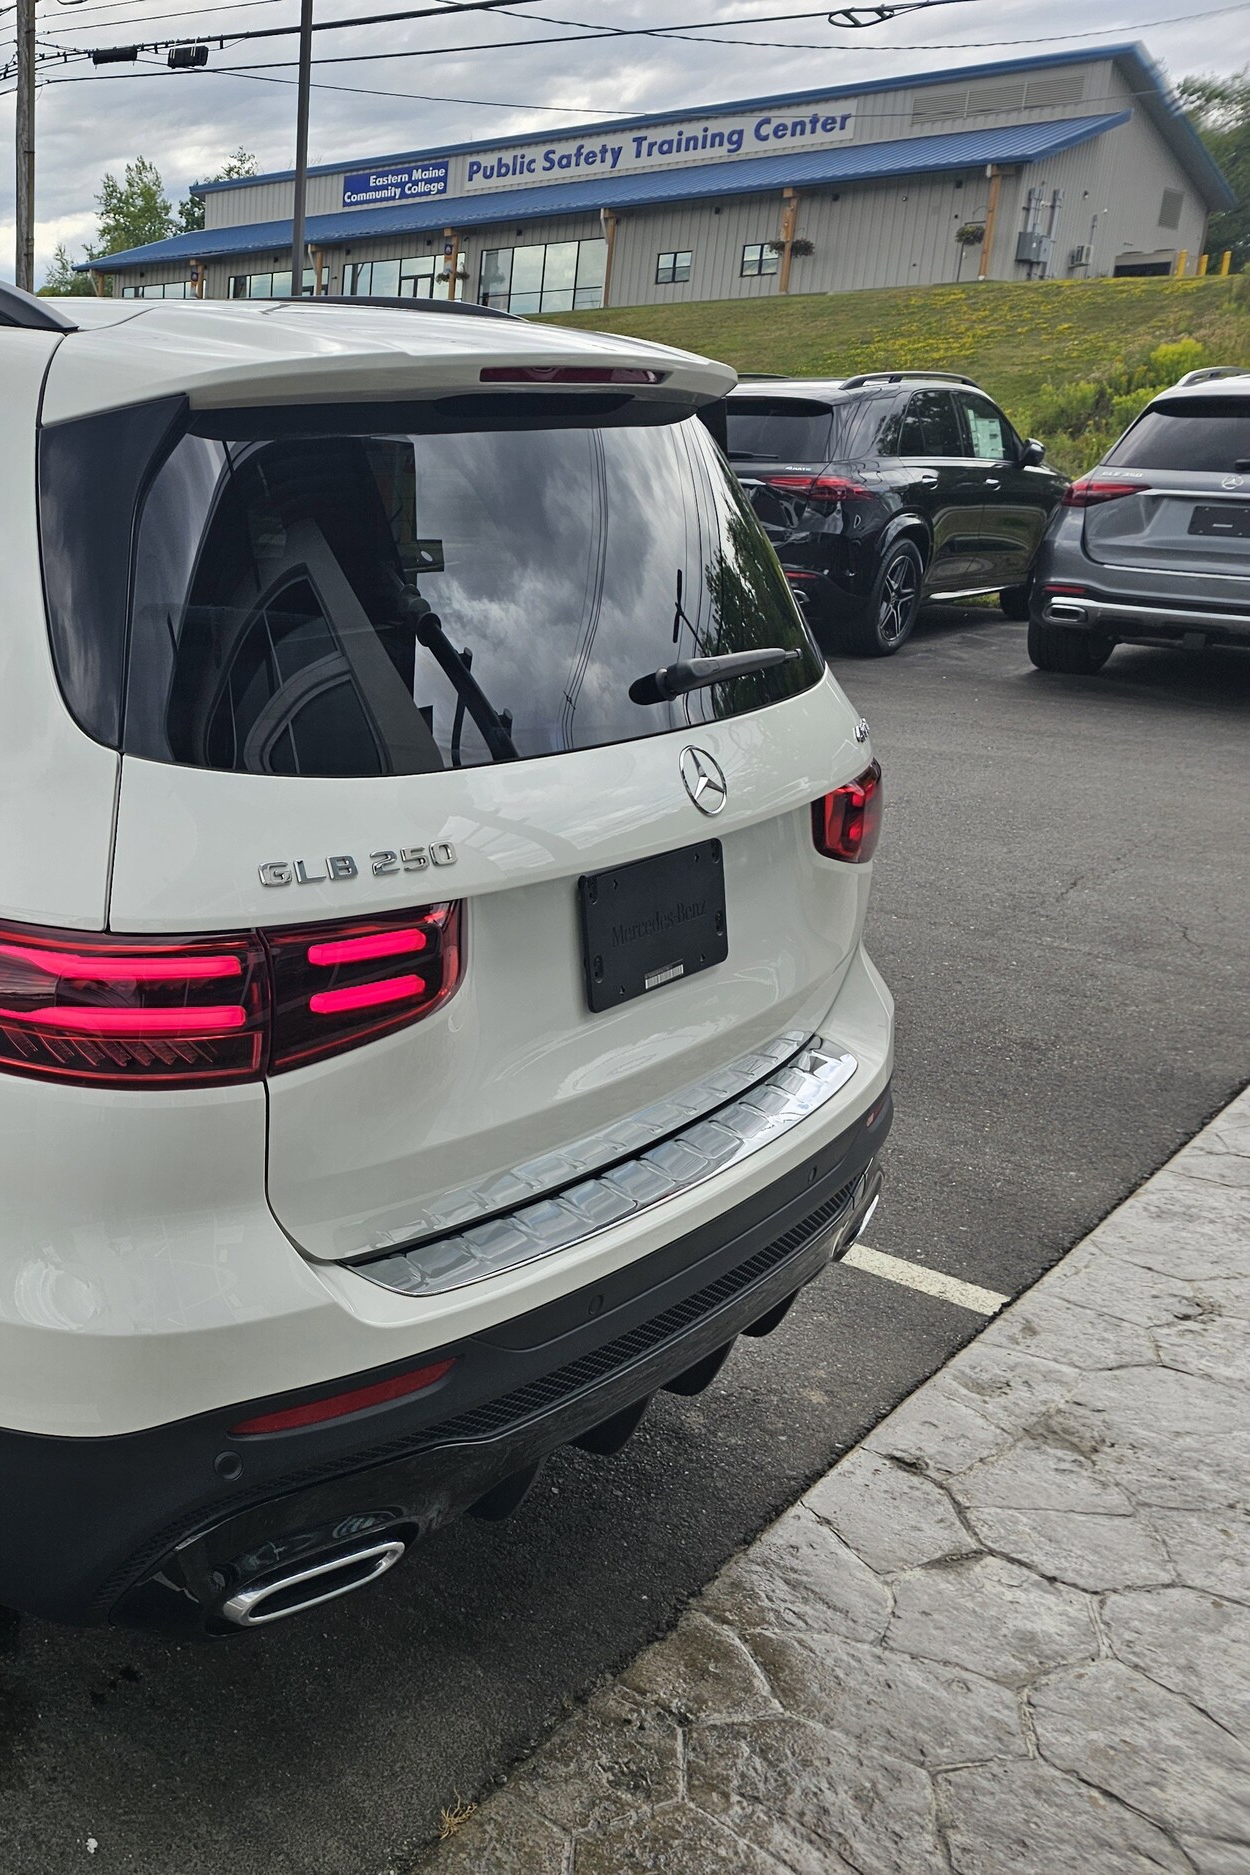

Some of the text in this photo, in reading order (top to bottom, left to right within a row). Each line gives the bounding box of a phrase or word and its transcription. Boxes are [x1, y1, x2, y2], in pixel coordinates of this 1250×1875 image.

[467, 113, 853, 182] Public Safety Training Center
[344, 181, 445, 203] Community College
[369, 167, 446, 187] Eastern Maine
[257, 839, 458, 888] GLB 250
[612, 899, 707, 948] Mercedes-Benz
